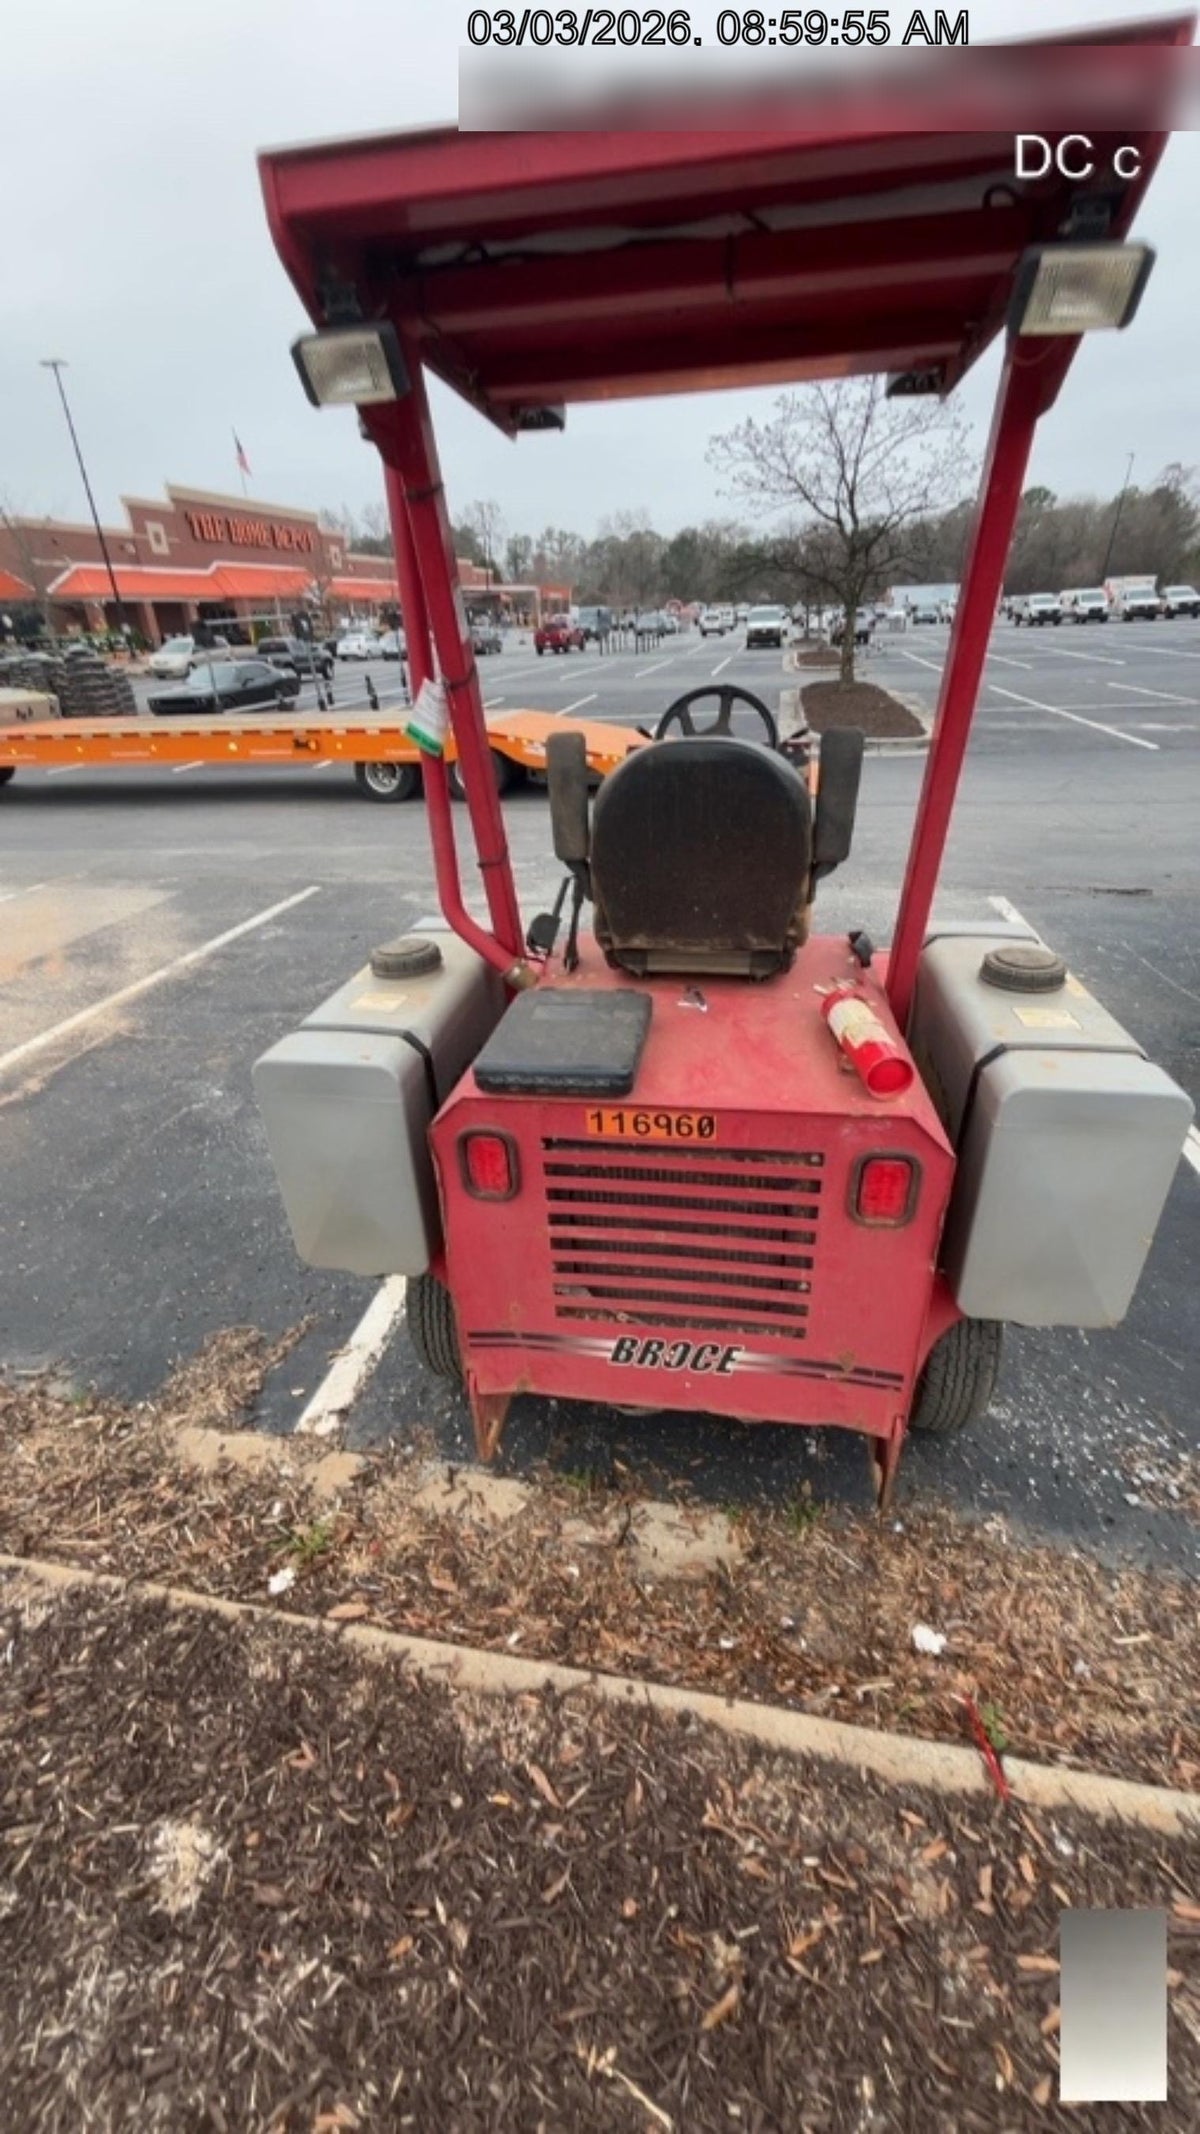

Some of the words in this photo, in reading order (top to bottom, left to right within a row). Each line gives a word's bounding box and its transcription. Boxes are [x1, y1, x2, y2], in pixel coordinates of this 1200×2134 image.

[185, 511, 225, 542] THE
[226, 517, 268, 547] HOME
[270, 524, 314, 552] DEPOT
[590, 1110, 715, 1138] 116960
[609, 1335, 744, 1375] BROCE
